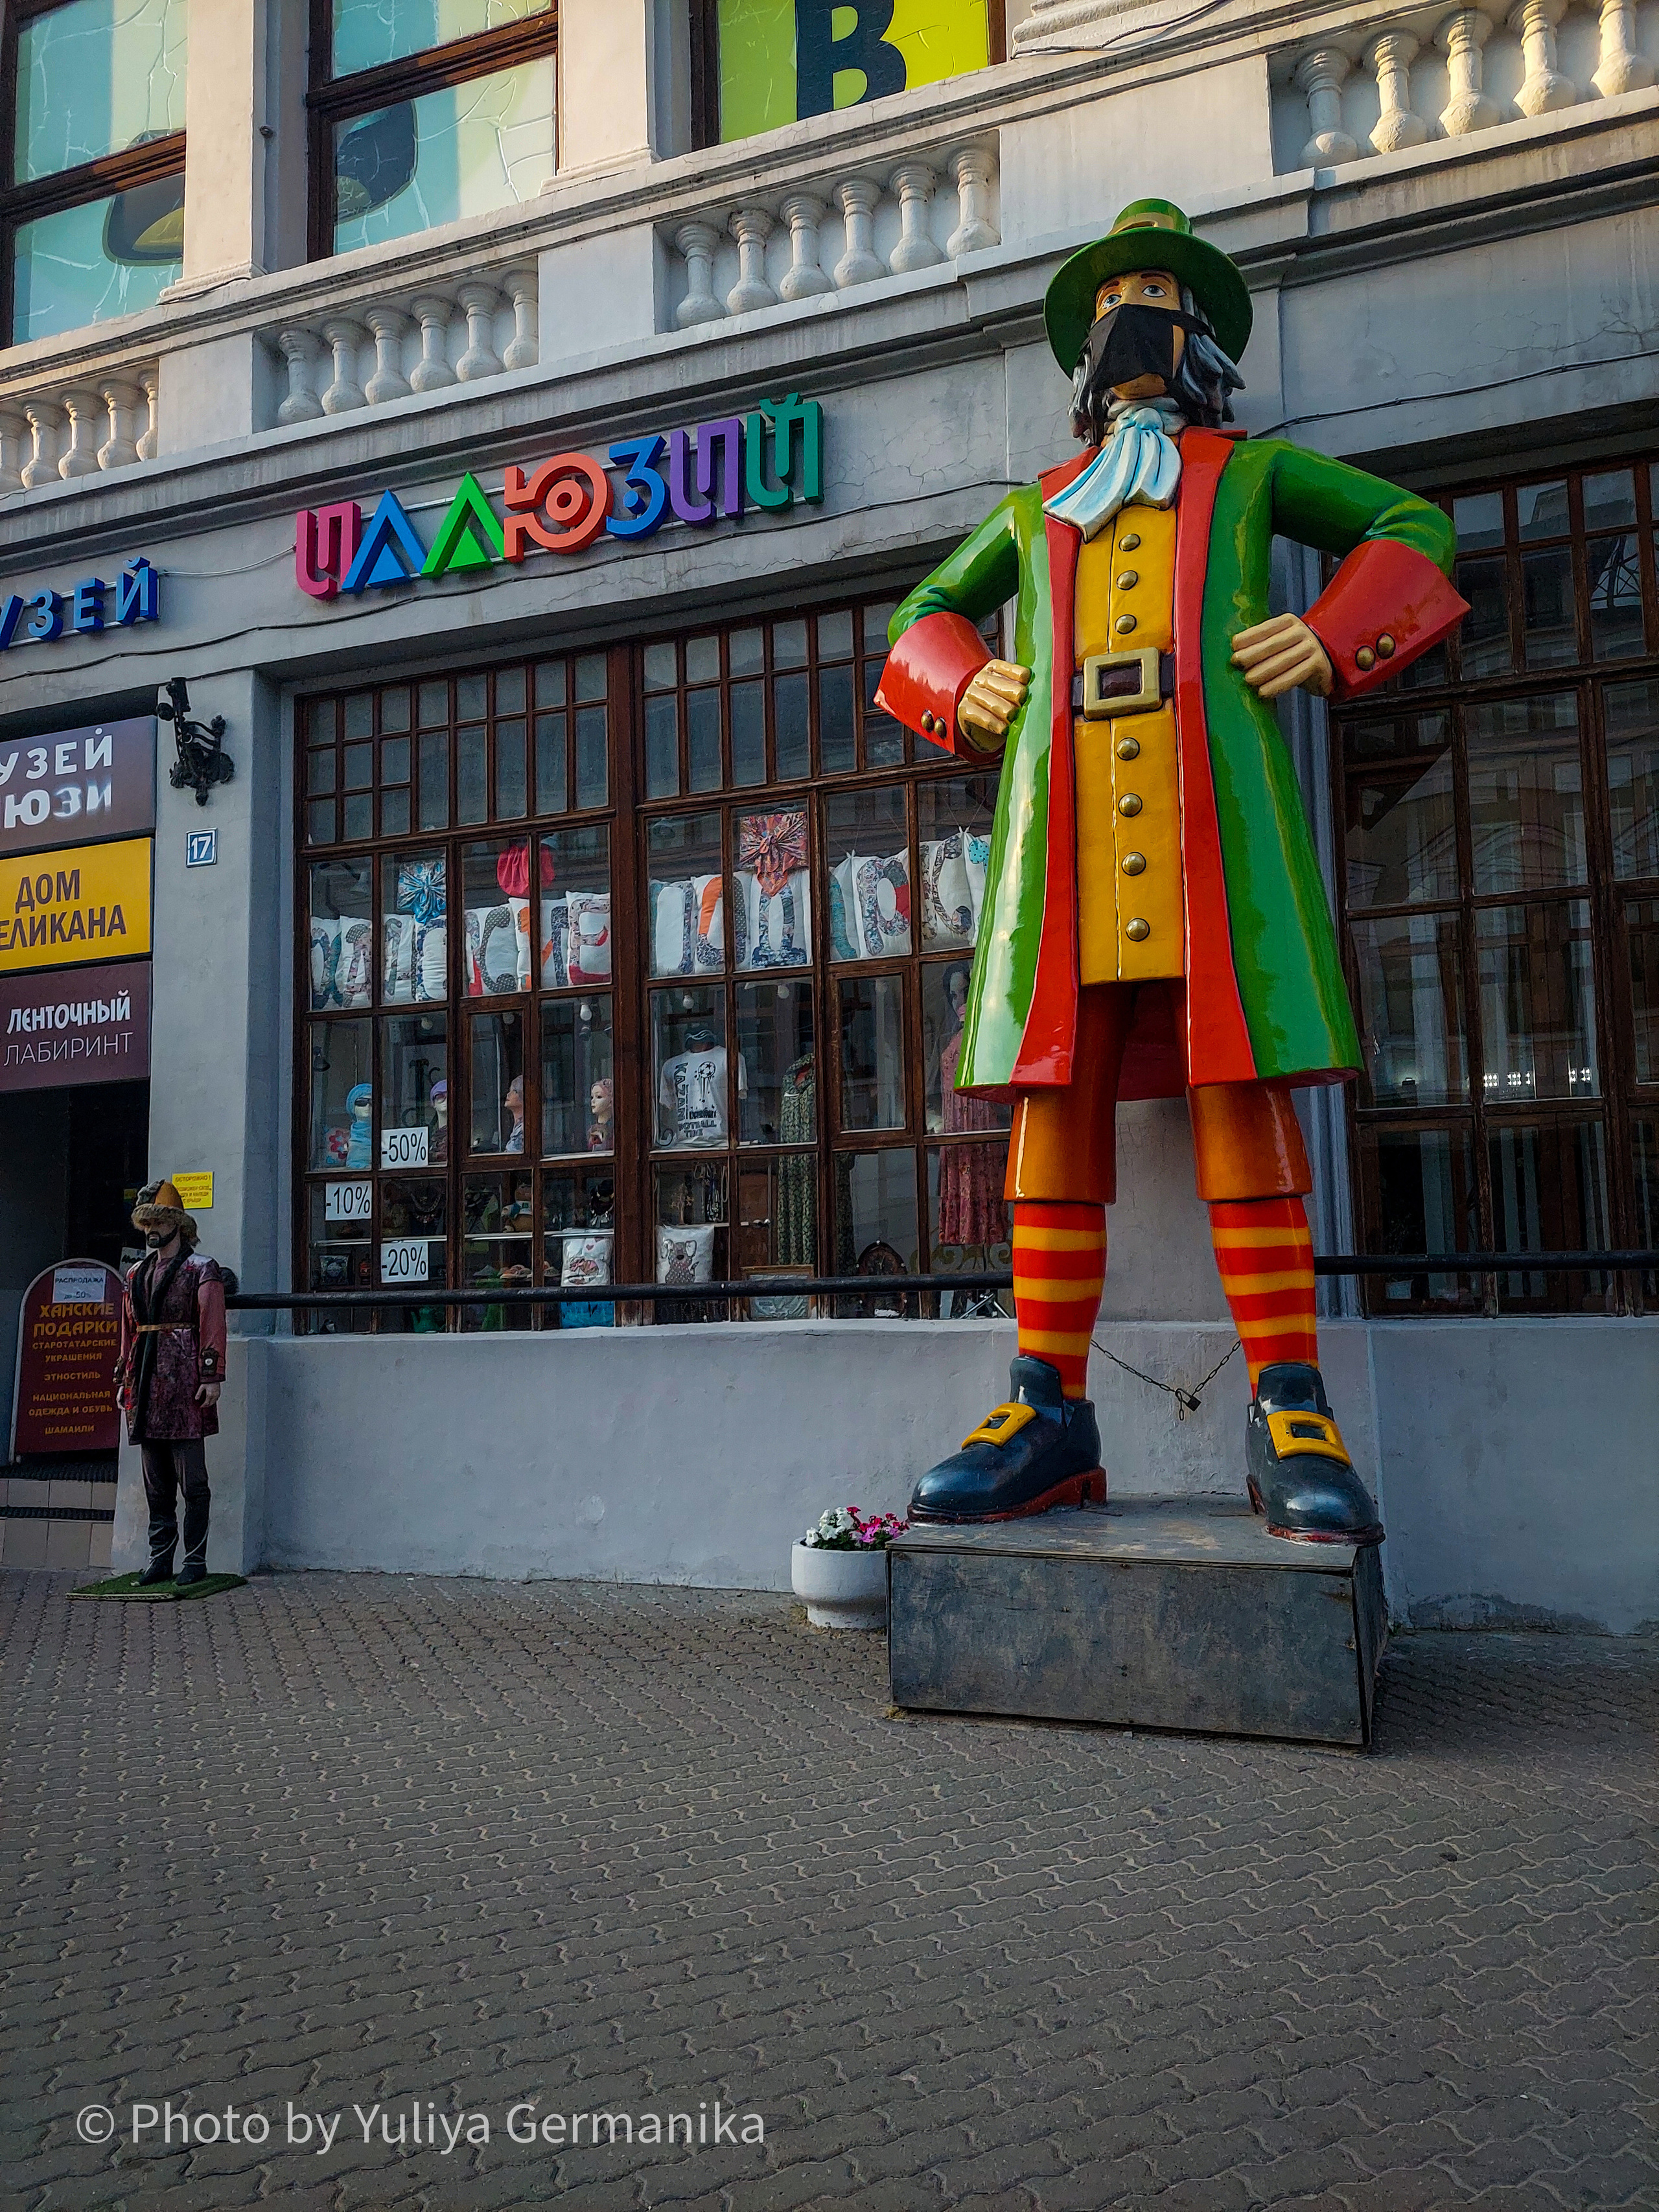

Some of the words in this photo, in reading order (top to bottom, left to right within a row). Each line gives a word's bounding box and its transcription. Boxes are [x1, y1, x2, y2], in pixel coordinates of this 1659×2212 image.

[191, 835, 211, 860] 17
[15, 868, 80, 914] ДОМ
[6, 989, 130, 1035] ЛЕНТОЧНЫЙ
[3, 1032, 133, 1066] ЛАБИРИНТ
[382, 1132, 426, 1163] -50%
[326, 1185, 371, 1215] -10%
[381, 1246, 426, 1277] -20%
[39, 1302, 115, 1318] ХАНСКИЕ
[33, 1320, 119, 1338] ПОДАРКИ
[32, 1338, 117, 1350] СТАРОТАТАРСКИЕ
[45, 1353, 102, 1363] УКРАШЕНИЯ
[43, 1371, 102, 1382] ЭТНОСТИЛЬ
[32, 1390, 111, 1403] НАЦИОНАЛЬНАЯ
[29, 1406, 70, 1417] ОДЕЖДА
[82, 1404, 113, 1414] ОБУВЬ
